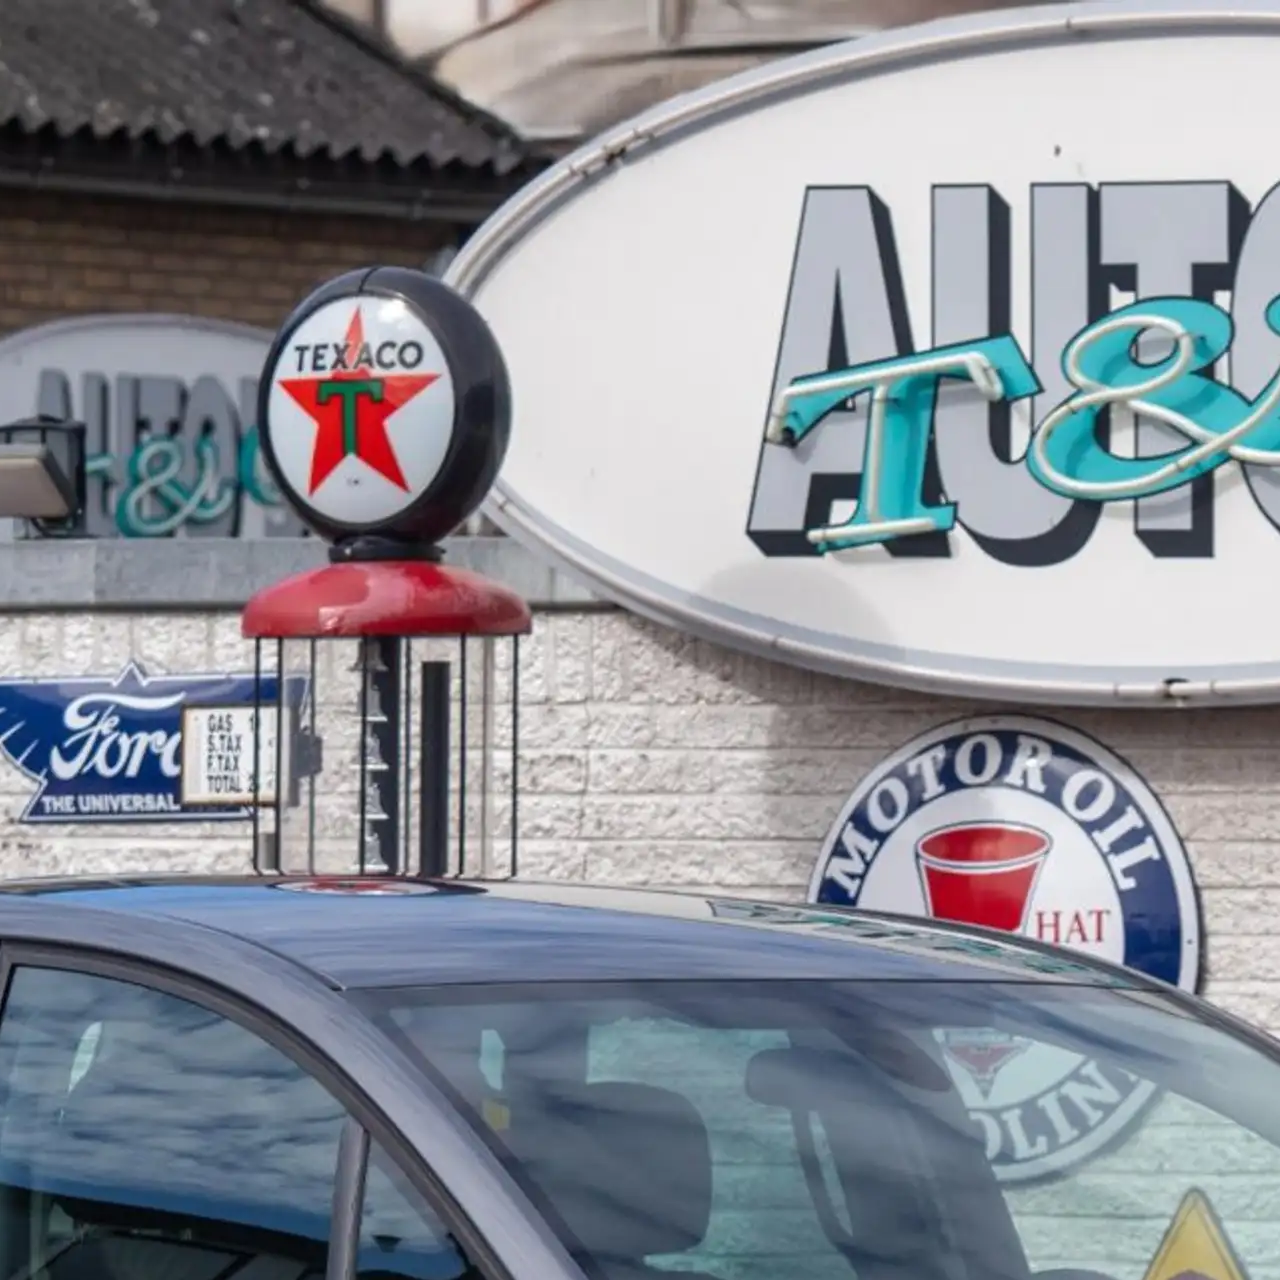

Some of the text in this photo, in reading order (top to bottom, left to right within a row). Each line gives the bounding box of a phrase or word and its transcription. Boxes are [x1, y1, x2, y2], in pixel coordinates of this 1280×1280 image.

[294, 340, 424, 372] TEXACO
[207, 713, 233, 732] GAS
[207, 774, 242, 794] TOTAL
[42, 793, 181, 813] THE UNIVERSAL
[827, 733, 1162, 899] MOTOR OIL
[1035, 909, 1111, 948] HAT
